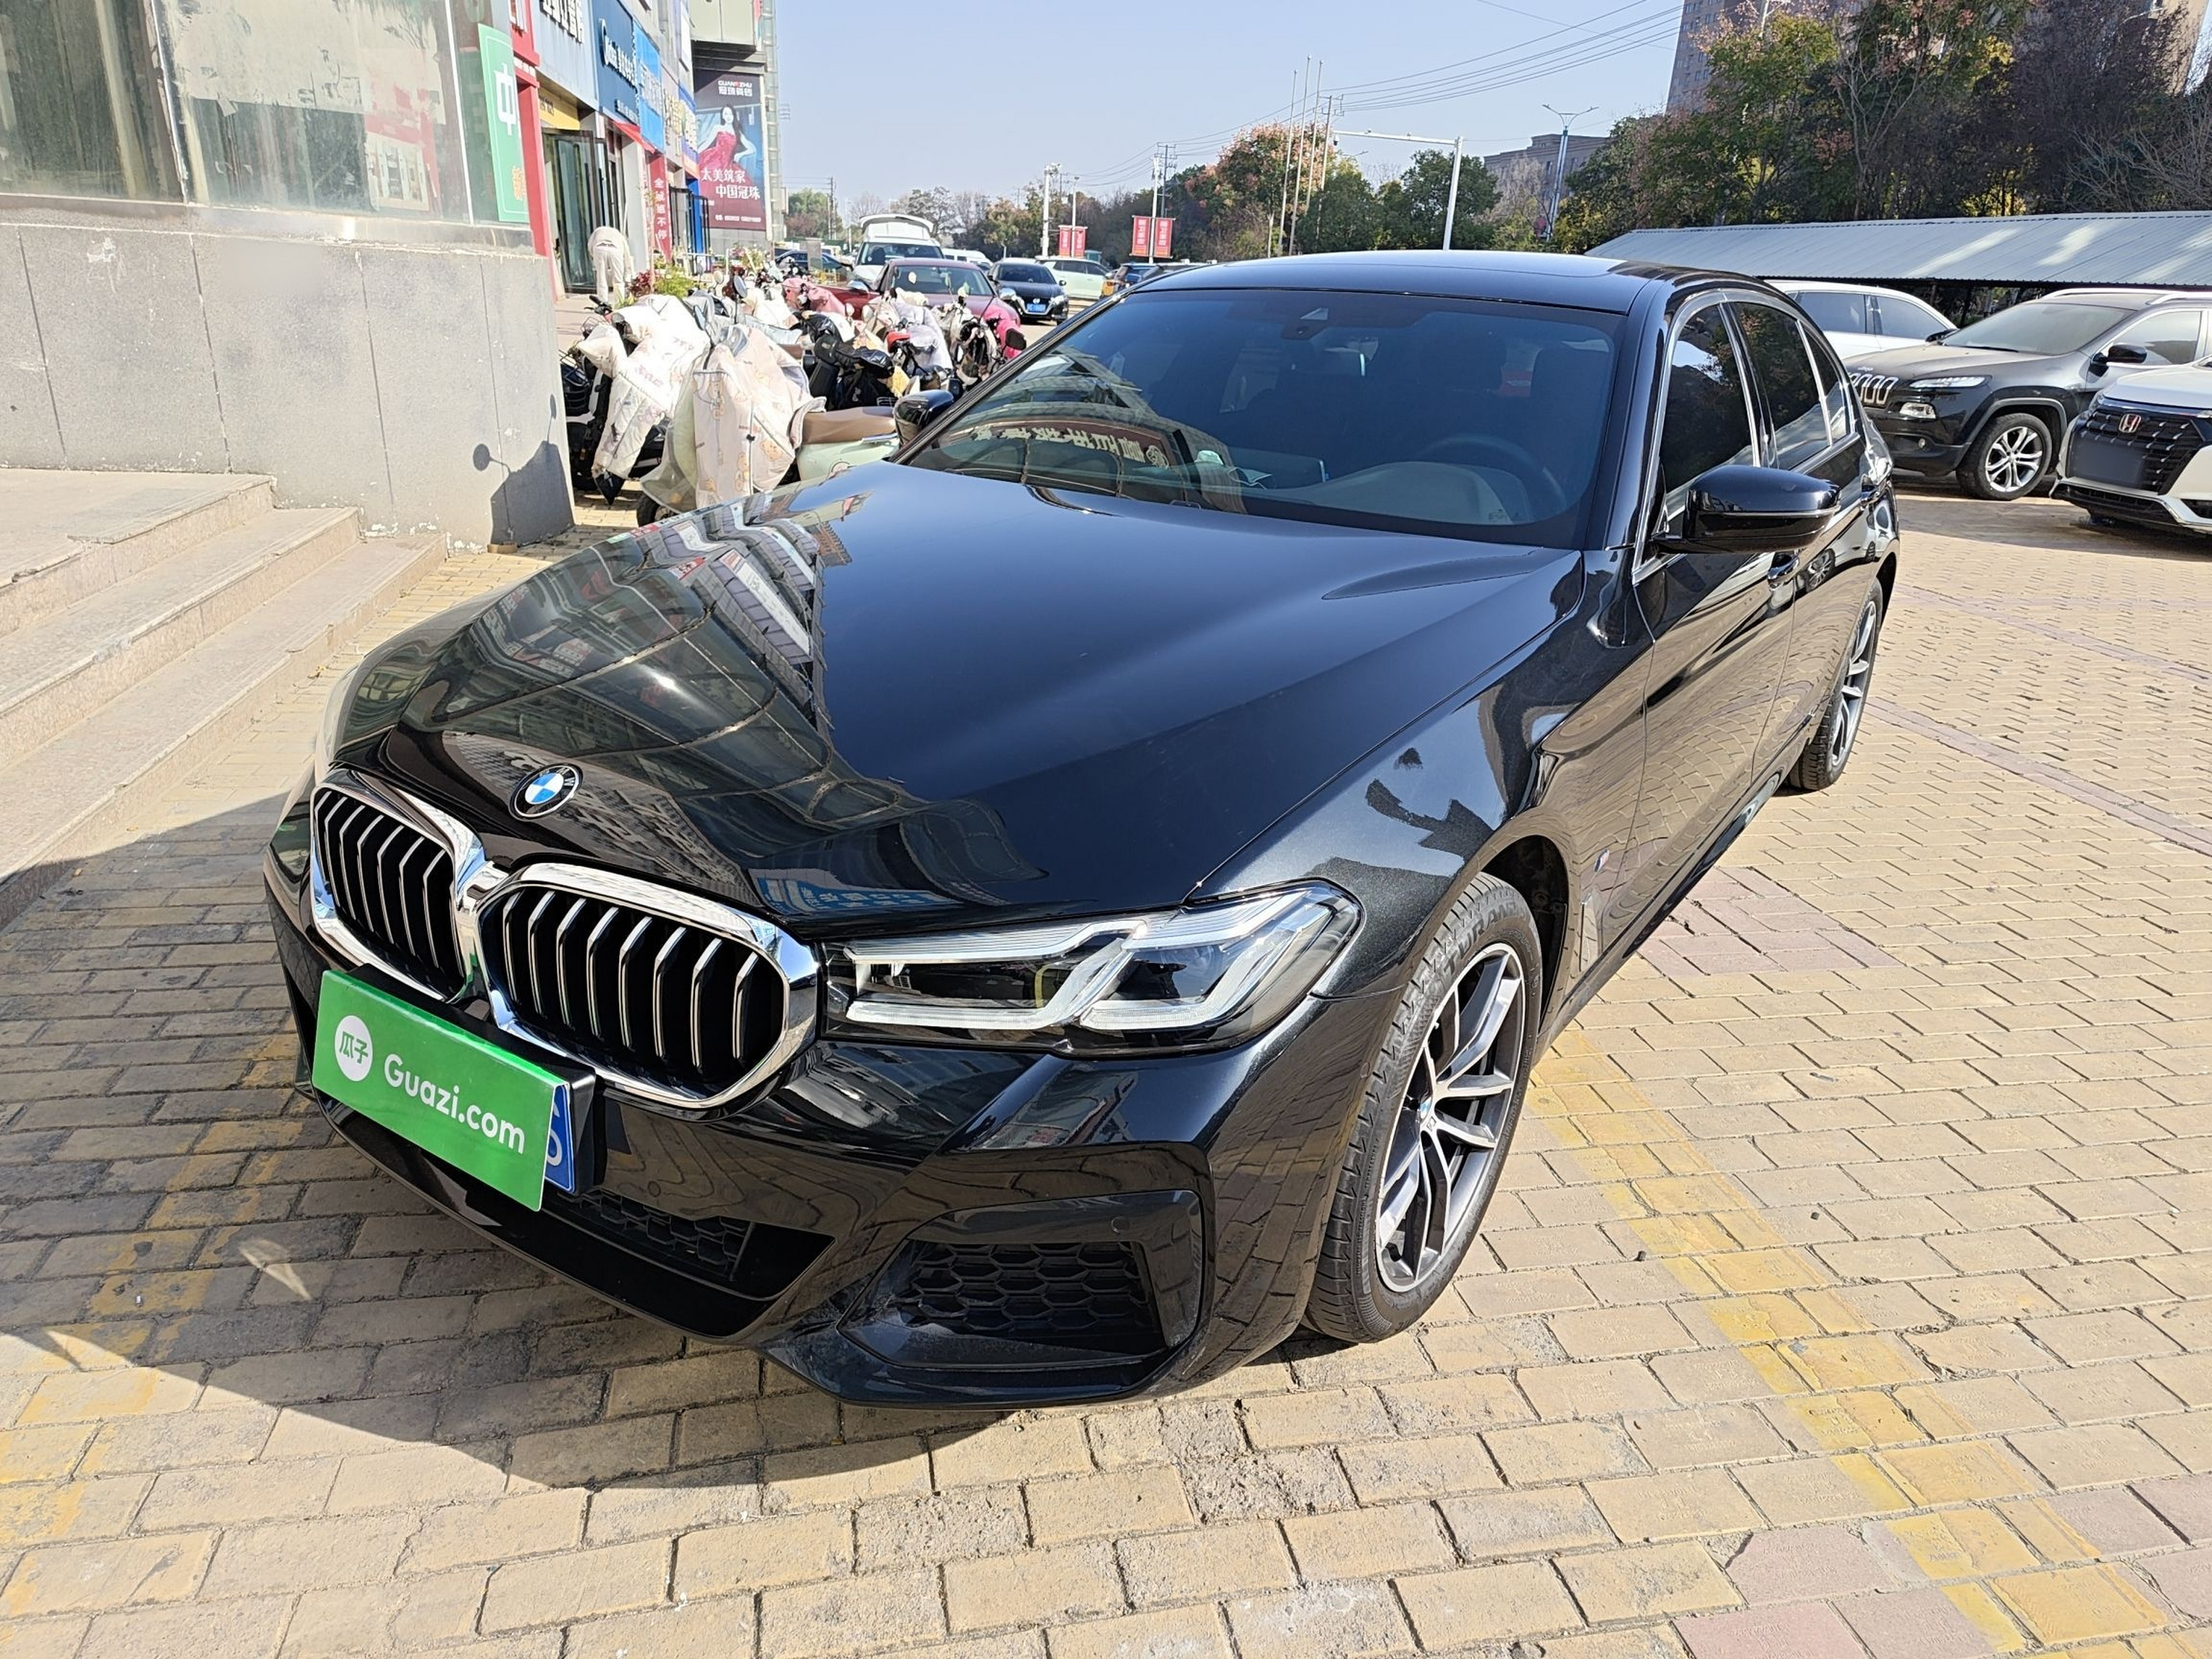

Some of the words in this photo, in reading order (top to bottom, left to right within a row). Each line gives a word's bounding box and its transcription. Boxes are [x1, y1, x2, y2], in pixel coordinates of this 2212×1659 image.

[715, 184, 760, 200] 中国冠珠
[339, 1031, 369, 1065] 瓜子
[384, 1054, 525, 1154] Guazi.com
